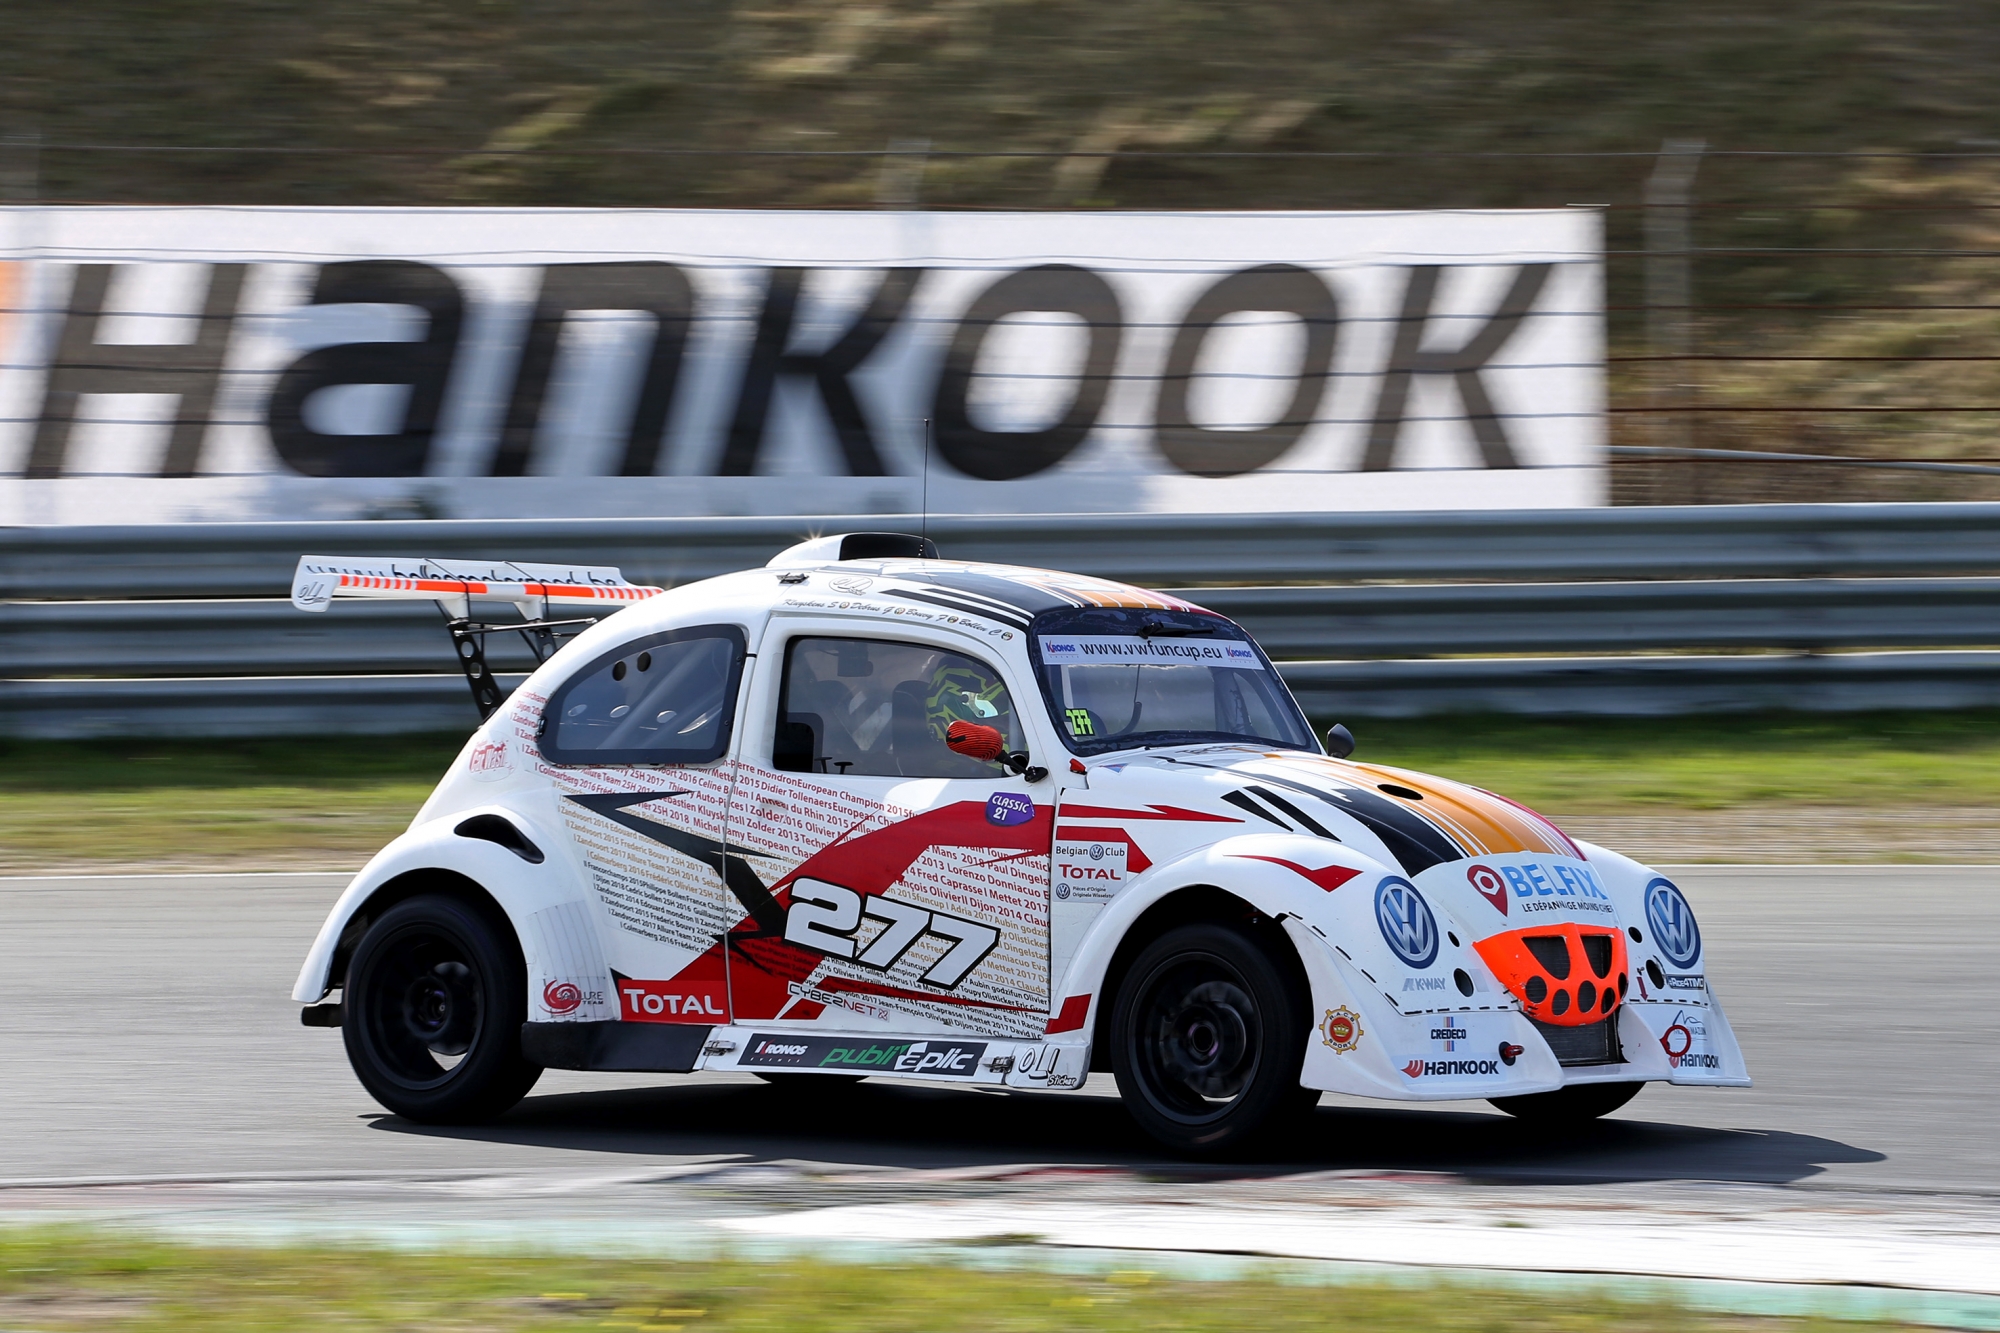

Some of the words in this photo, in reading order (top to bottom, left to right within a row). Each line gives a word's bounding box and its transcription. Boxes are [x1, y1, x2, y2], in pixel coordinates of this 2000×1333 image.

[958, 618, 988, 632] Bollen
[1080, 640, 1222, 661] www.vwfuncup.eu
[738, 774, 760, 789] 2015
[760, 781, 786, 797] Didier
[839, 789, 884, 813] Champion
[992, 794, 1029, 814] CLASSIC
[678, 770, 696, 785] 2016
[790, 802, 802, 814] du
[804, 806, 824, 821] Rhin
[826, 813, 848, 828] 2015
[931, 845, 956, 860] Mans
[986, 860, 1008, 874] Paul
[993, 807, 1008, 821] 21
[646, 773, 665, 788] 2017
[804, 820, 834, 839] Olivier
[921, 855, 944, 870] 2013
[946, 862, 986, 883] Lorenzo
[987, 874, 1040, 898] Donniacuo
[652, 804, 668, 817] 25H
[669, 809, 689, 824] 2018
[692, 816, 720, 835] Michel
[746, 832, 790, 855] European
[970, 896, 996, 915] Dijon
[998, 905, 1022, 920] 2014
[1056, 846, 1088, 857] Belgian
[1105, 847, 1125, 857] Club
[746, 818, 775, 835] Zolder
[776, 826, 800, 842] 2013
[918, 868, 938, 883] Fred
[940, 874, 982, 897] Caprasse
[1024, 899, 1048, 915] 2017
[686, 859, 703, 873] 2017
[1030, 960, 1046, 973] Eva
[950, 904, 972, 917] Adria
[974, 910, 992, 923] 2017
[994, 916, 1018, 931] Aubin
[1522, 903, 1532, 912] LE
[648, 858, 666, 872] Team
[988, 888, 1022, 907] Mettet
[1016, 968, 1036, 982] 2017
[784, 876, 1001, 990] 277
[987, 959, 1014, 976] Mettet
[994, 973, 1014, 987] 2014
[1016, 979, 1046, 996] Claude
[1430, 1028, 1467, 1040] CREDECO
[755, 1039, 808, 1055] KRONOS
